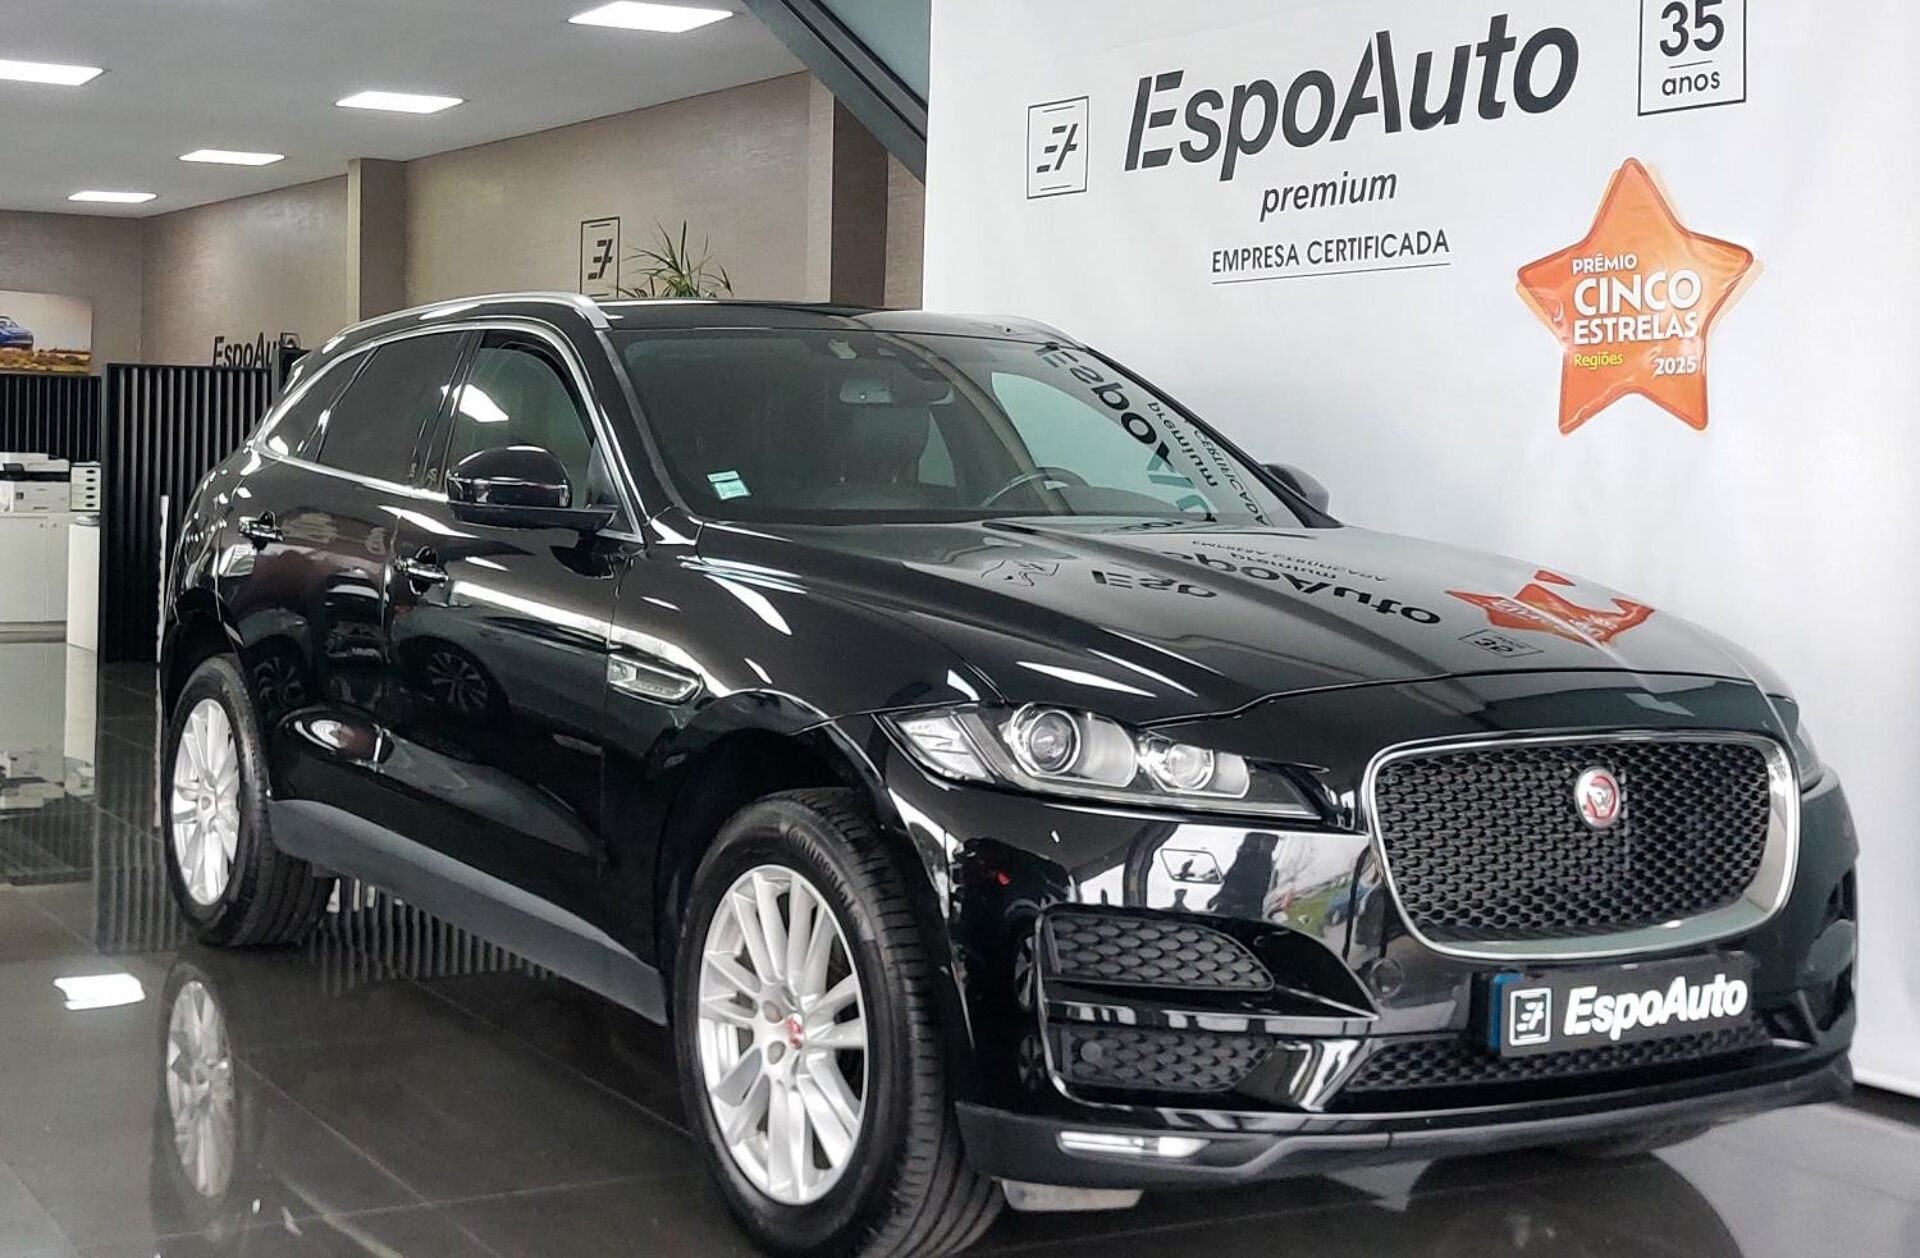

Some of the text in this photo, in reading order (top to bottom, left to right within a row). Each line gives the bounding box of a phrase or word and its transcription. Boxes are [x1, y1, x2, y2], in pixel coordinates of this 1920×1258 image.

[1659, 0, 1725, 57] 35
[1124, 13, 1580, 183] EspoAuto
[1660, 69, 1721, 97] anos
[1259, 170, 1398, 223] premium
[1211, 228, 1451, 274] EMPRESA CERTIFICADA
[1574, 268, 1701, 317] CINCO
[1573, 311, 1699, 345] ESTRELAS
[1574, 350, 1625, 370] Regiões
[1652, 356, 1699, 376] 2025
[1563, 973, 1749, 1041] EspoAuto
